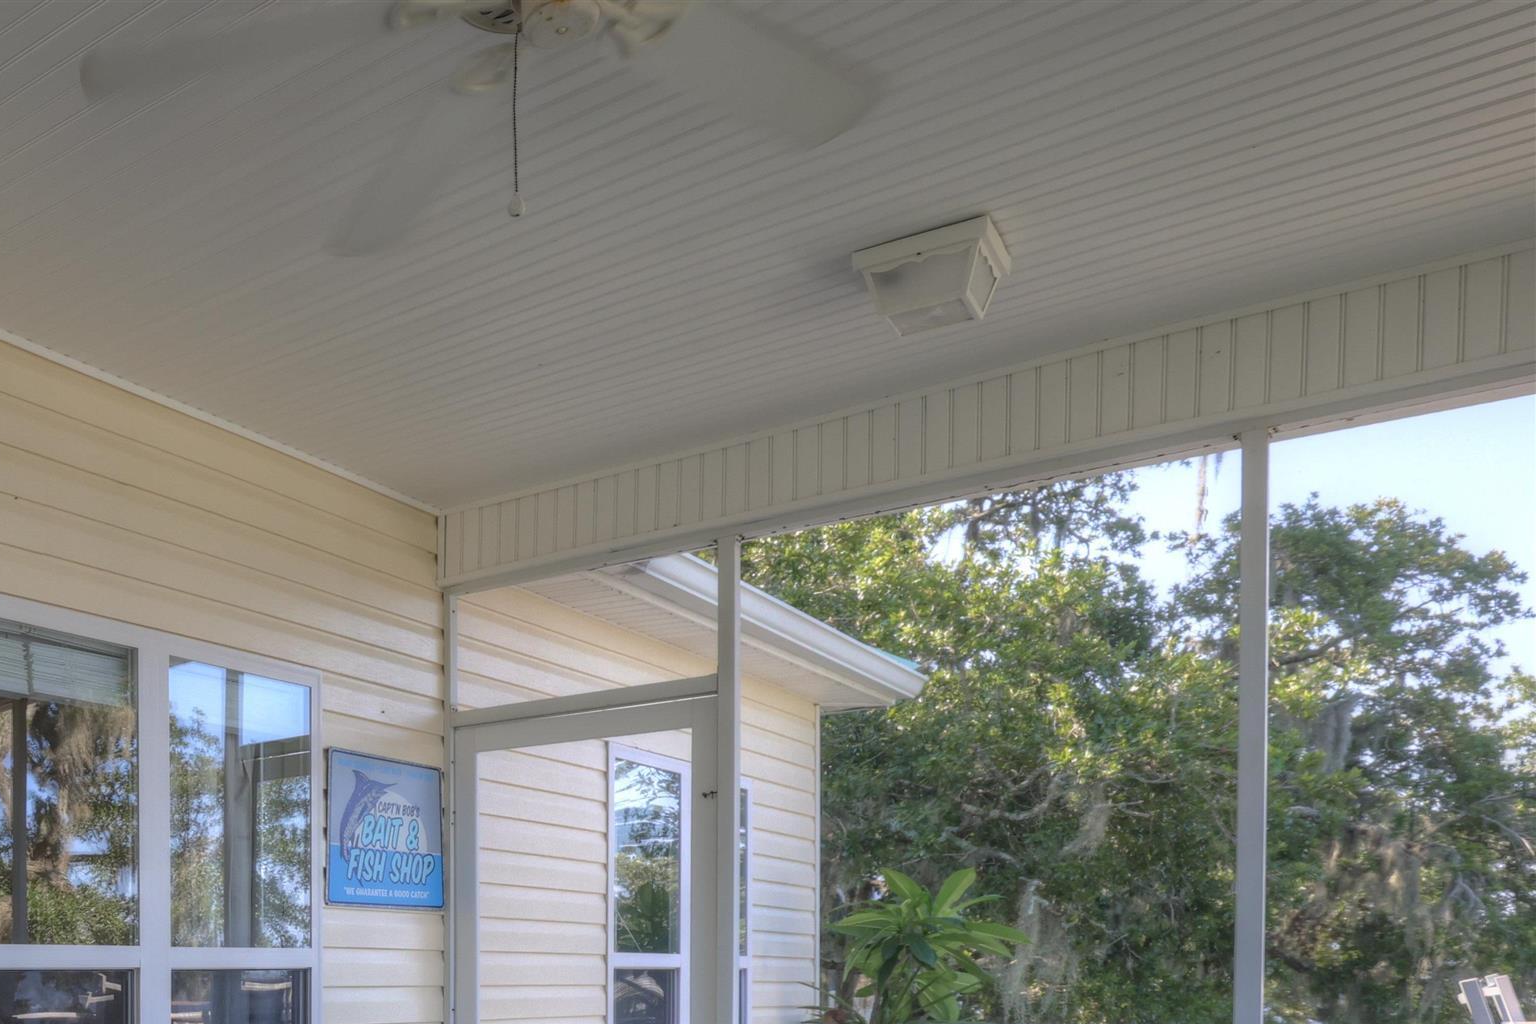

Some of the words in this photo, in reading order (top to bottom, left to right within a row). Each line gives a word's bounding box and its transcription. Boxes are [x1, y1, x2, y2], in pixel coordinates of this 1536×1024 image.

[360, 815, 403, 849] BAIT
[406, 819, 420, 851] &
[347, 848, 387, 884] FISH
[389, 853, 435, 886] SHOP
